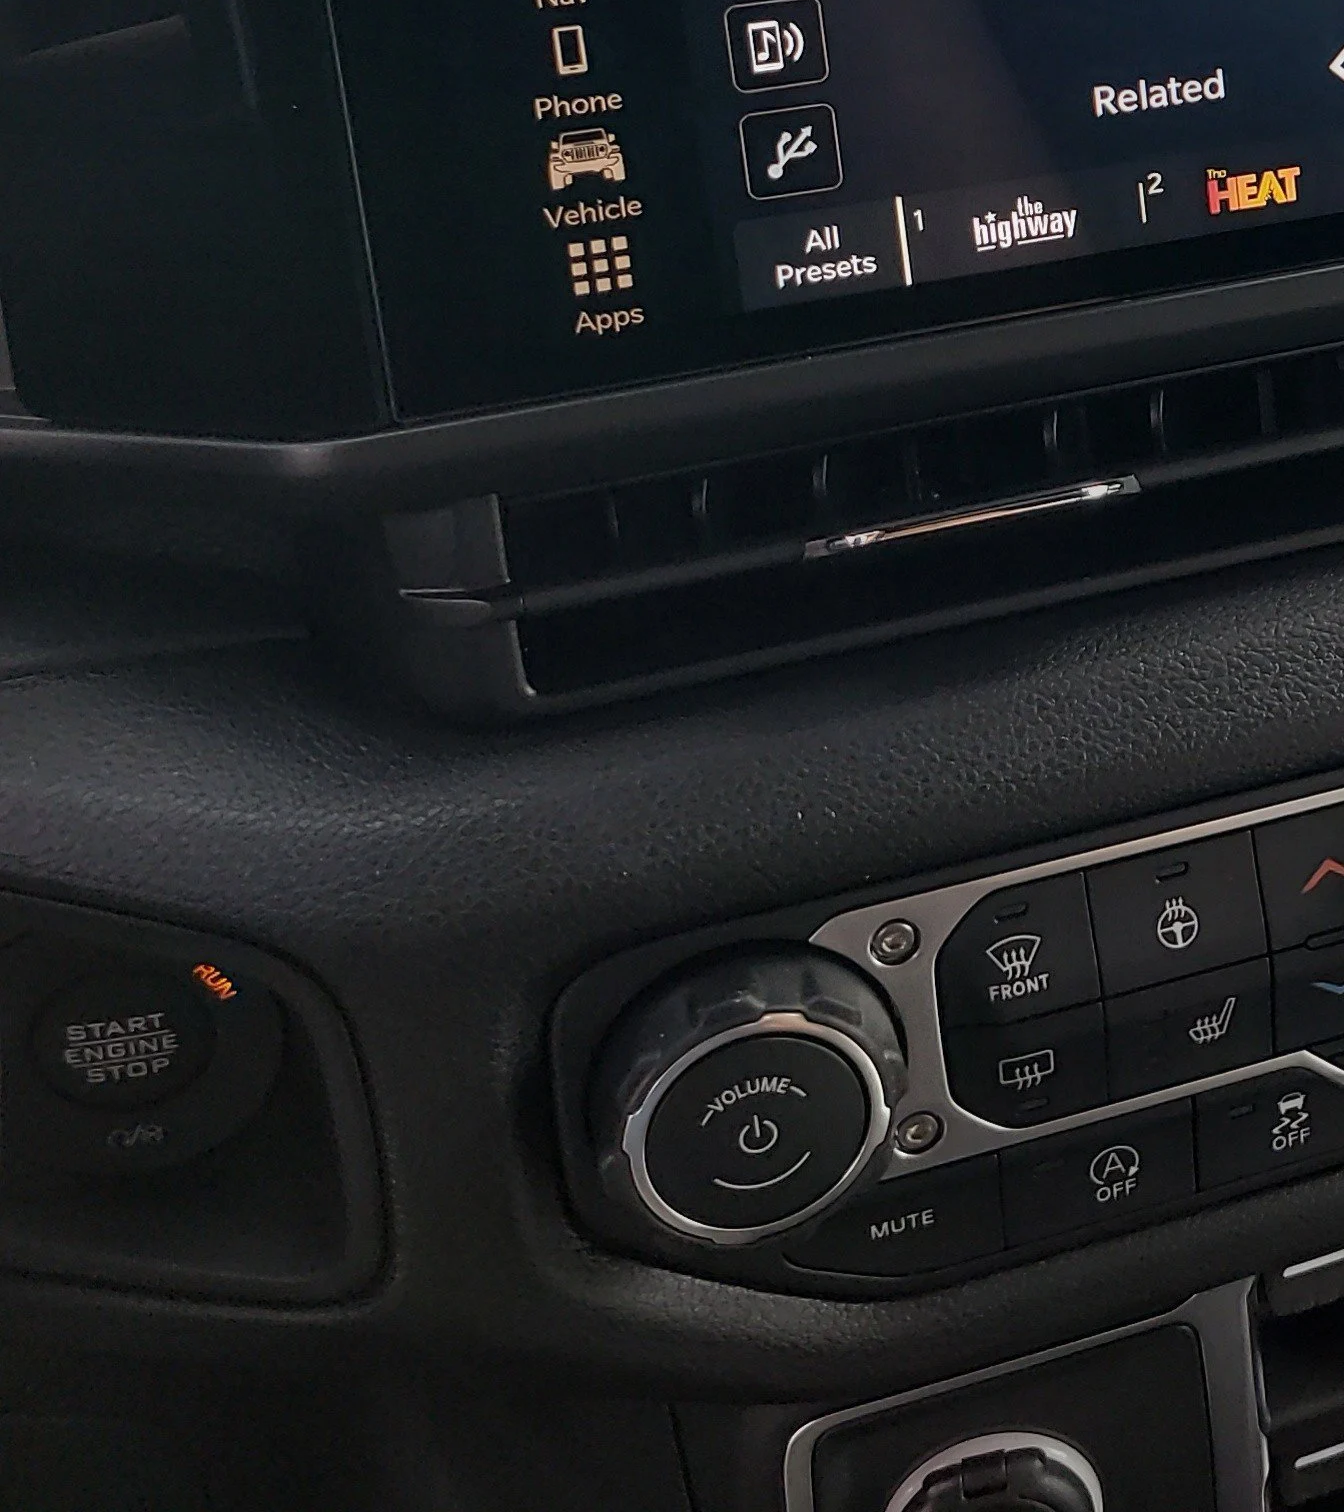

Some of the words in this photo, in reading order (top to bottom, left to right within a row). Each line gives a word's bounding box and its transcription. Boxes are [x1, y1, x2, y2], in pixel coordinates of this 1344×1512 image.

[533, 91, 623, 120] Phone
[1093, 68, 1226, 117] Related
[1148, 173, 1164, 194] 2
[1207, 167, 1300, 214] HEAT
[543, 197, 643, 229] Vehicle
[913, 209, 925, 231] 1
[1017, 195, 1043, 216] the
[805, 225, 840, 253] All
[973, 209, 1077, 249] highway
[775, 254, 877, 289] Presets
[575, 304, 645, 336] Apps
[193, 963, 237, 1000] RUN
[988, 973, 1050, 1002] FRONT
[65, 1012, 165, 1041] START
[64, 1033, 179, 1065] ENGINE
[85, 1057, 170, 1083] STOP
[708, 1077, 791, 1114] VOLUME
[1271, 1126, 1312, 1151] OFF
[1095, 1176, 1138, 1202] OFF
[870, 1209, 935, 1240] MUTE
